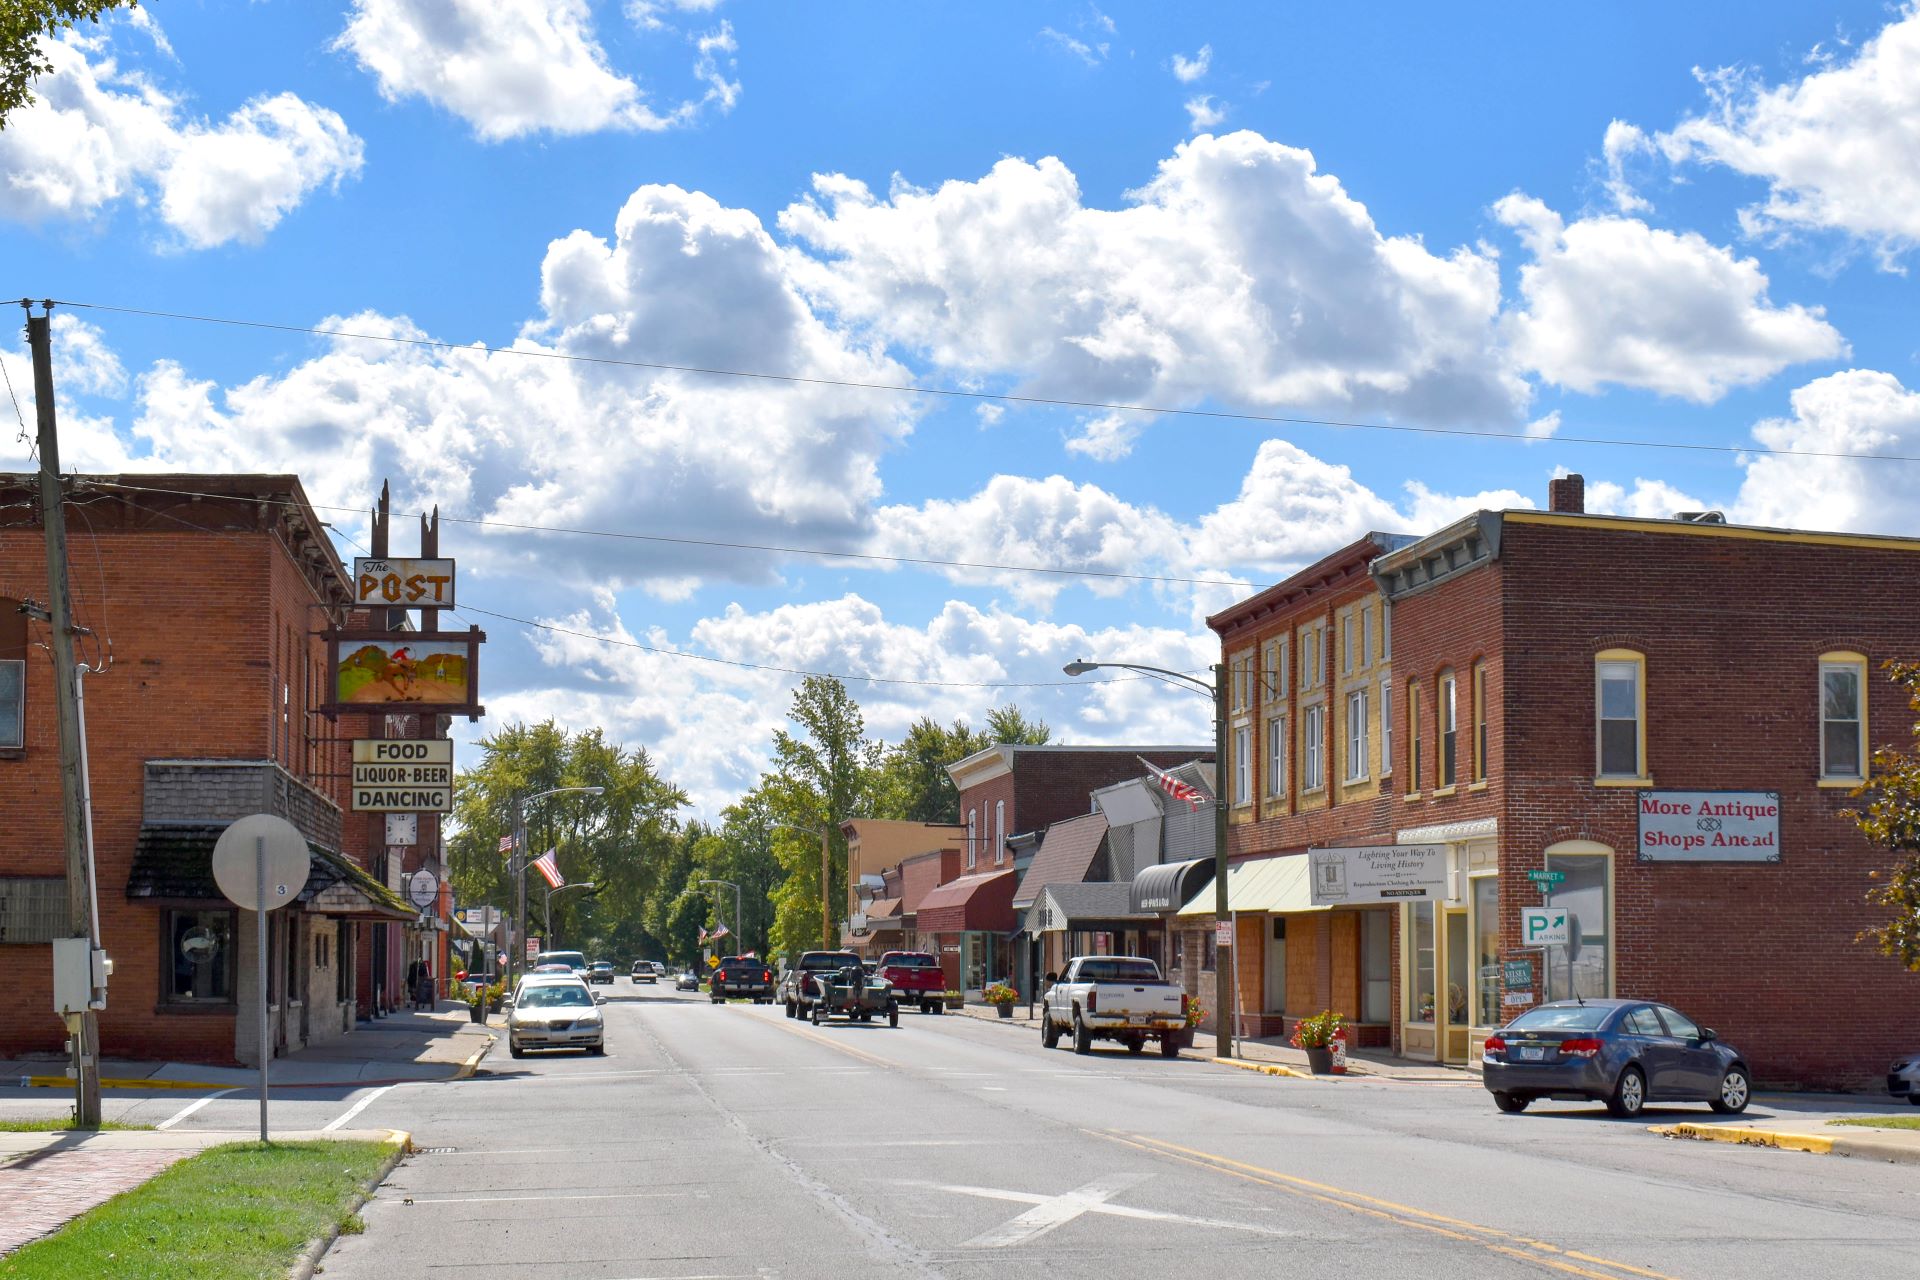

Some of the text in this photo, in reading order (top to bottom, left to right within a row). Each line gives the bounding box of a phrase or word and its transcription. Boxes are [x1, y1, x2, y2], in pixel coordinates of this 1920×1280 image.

[363, 560, 389, 572] The
[360, 572, 450, 602] POST
[377, 744, 428, 759] FOOD
[356, 767, 448, 783] LIQUOR-BEER
[359, 791, 443, 807] DANCING
[1641, 800, 1778, 820] More Antique
[1644, 831, 1706, 850] Shops
[1359, 848, 1436, 860] Lighting Your Way To
[1370, 860, 1425, 871] Living History
[1533, 872, 1558, 881] MARKET
[278, 885, 286, 895] 3
[1510, 995, 1528, 1003] OPEN
